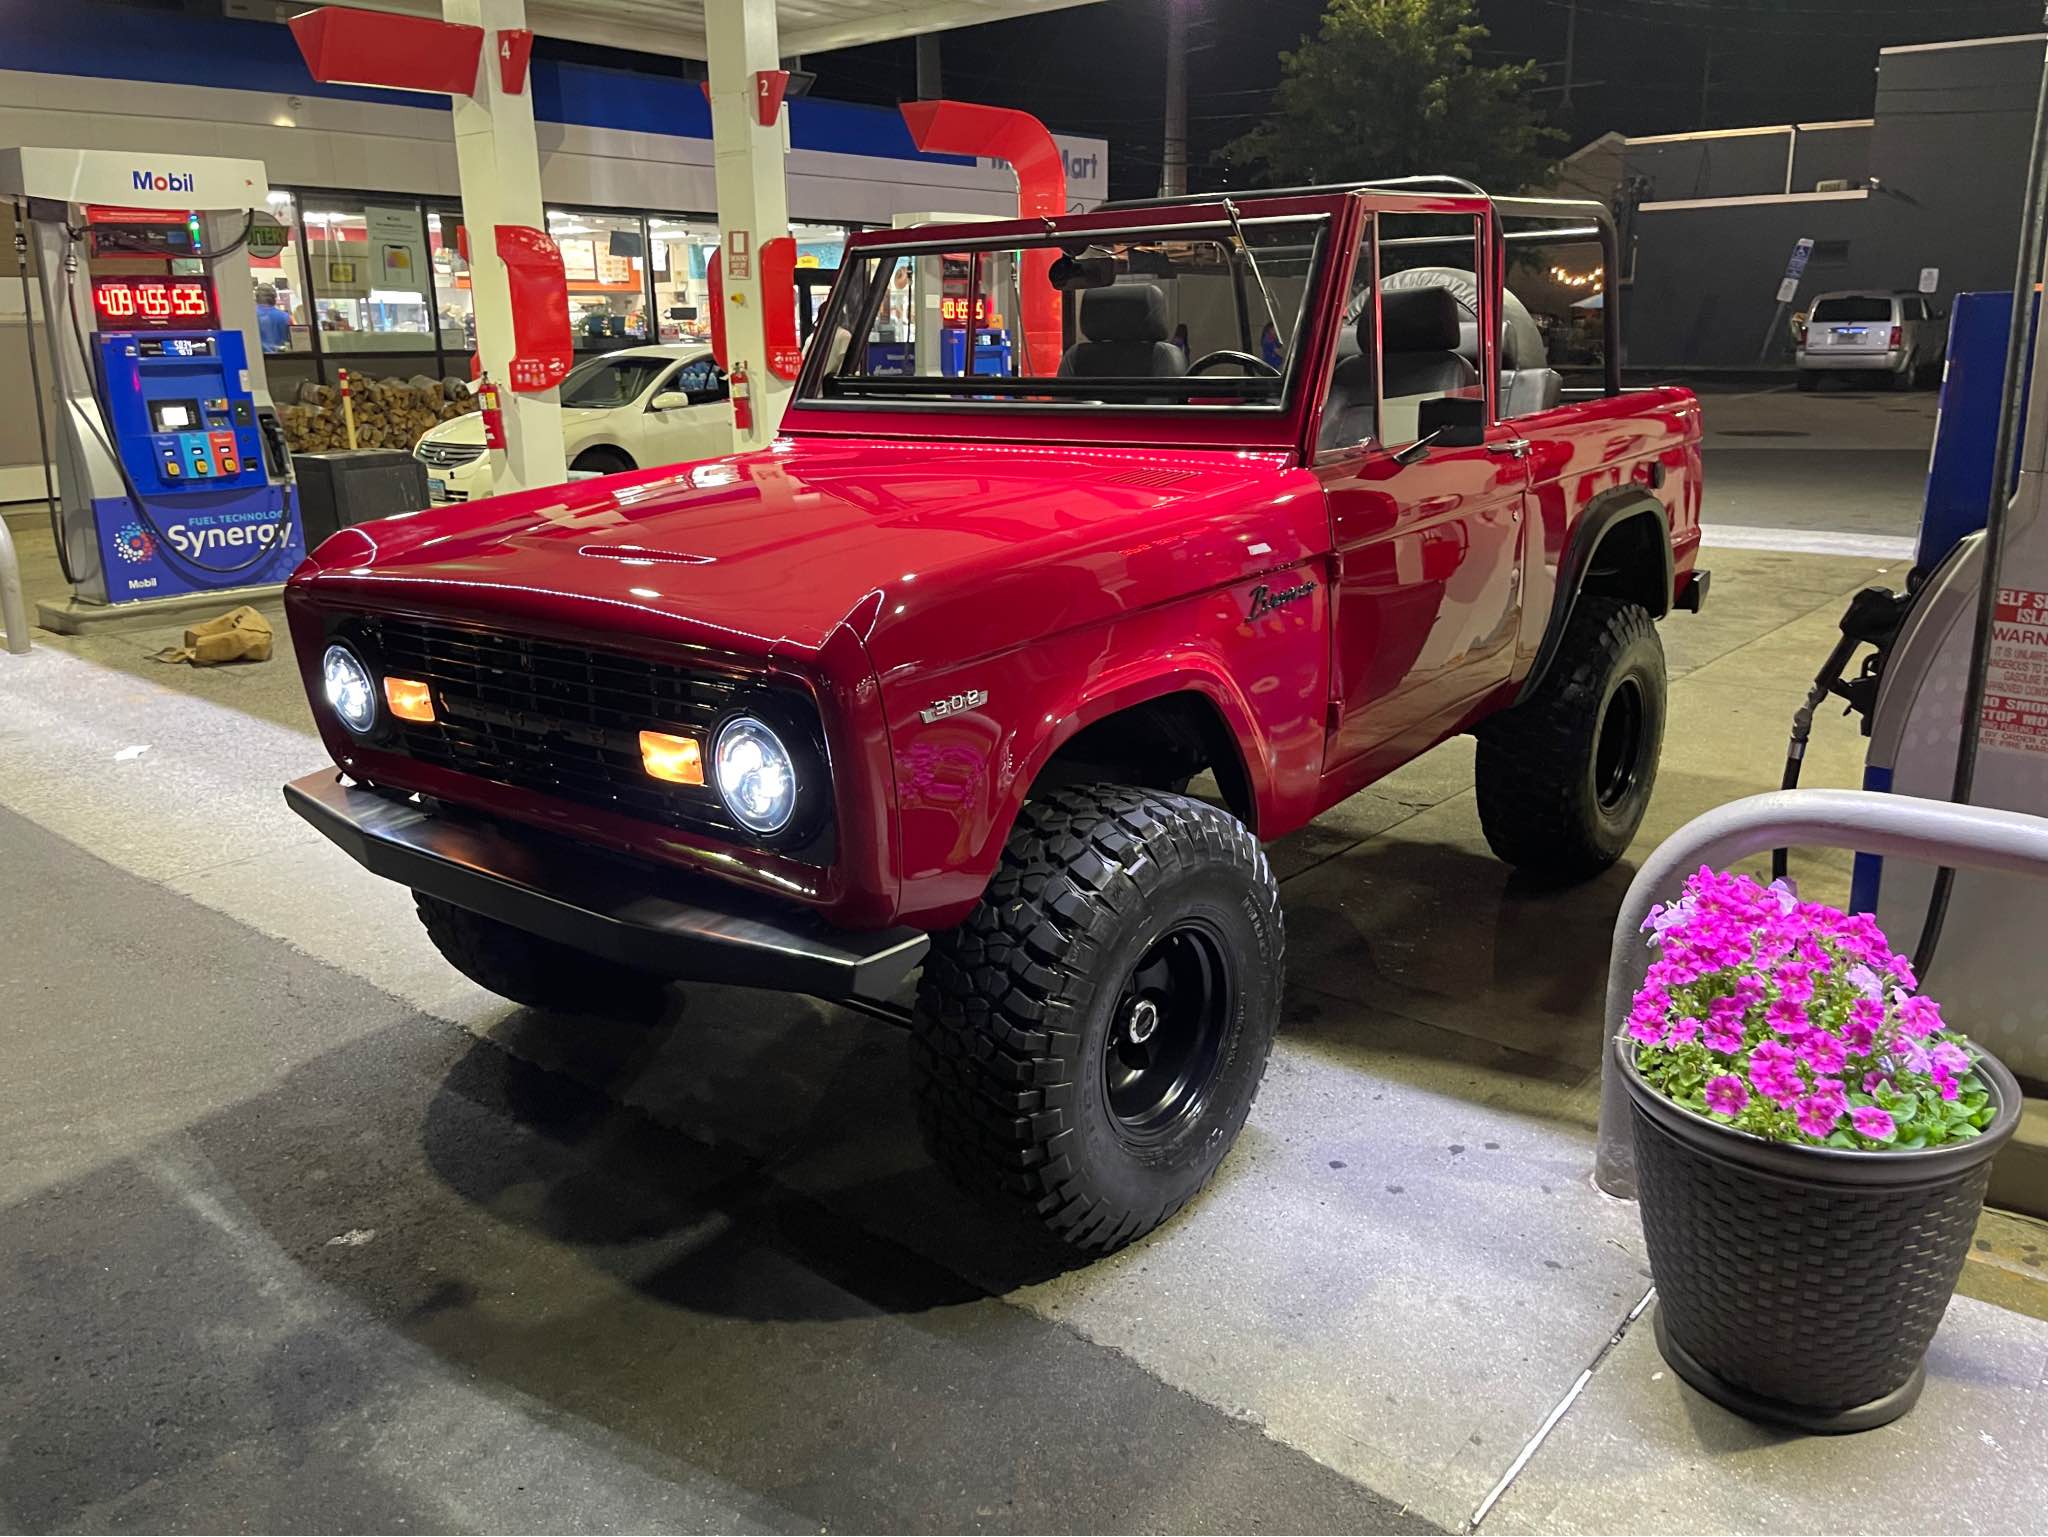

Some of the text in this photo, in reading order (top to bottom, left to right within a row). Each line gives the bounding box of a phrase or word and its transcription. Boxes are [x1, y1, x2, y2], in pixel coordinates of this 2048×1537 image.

[500, 39, 511, 60] 4
[760, 79, 769, 96] 2
[132, 170, 194, 192] Mobil
[188, 510, 289, 526] FUEL TECHNOLOG
[167, 522, 293, 557] Synergy
[128, 577, 157, 590] Mobil
[1993, 626, 2048, 647] WARN
[934, 689, 979, 715] 302
